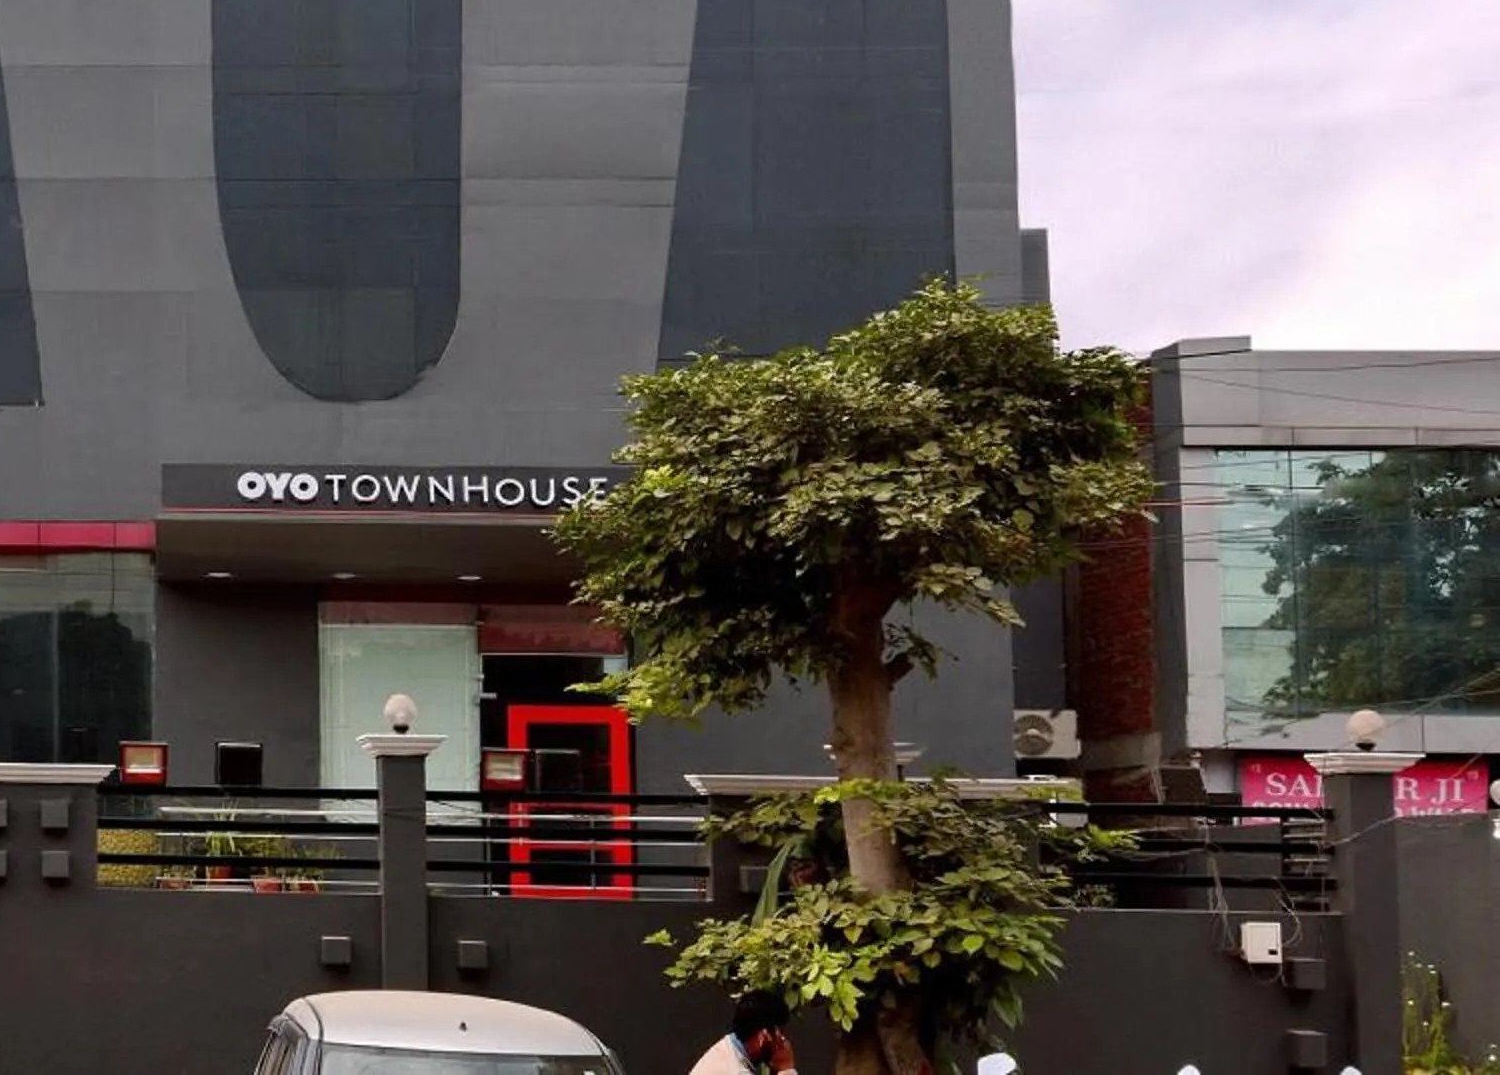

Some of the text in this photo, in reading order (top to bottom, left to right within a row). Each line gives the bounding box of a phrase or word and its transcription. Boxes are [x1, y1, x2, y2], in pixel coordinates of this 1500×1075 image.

[237, 471, 608, 506] OYO TOWNHOUSE
[1430, 778, 1465, 805] JI
